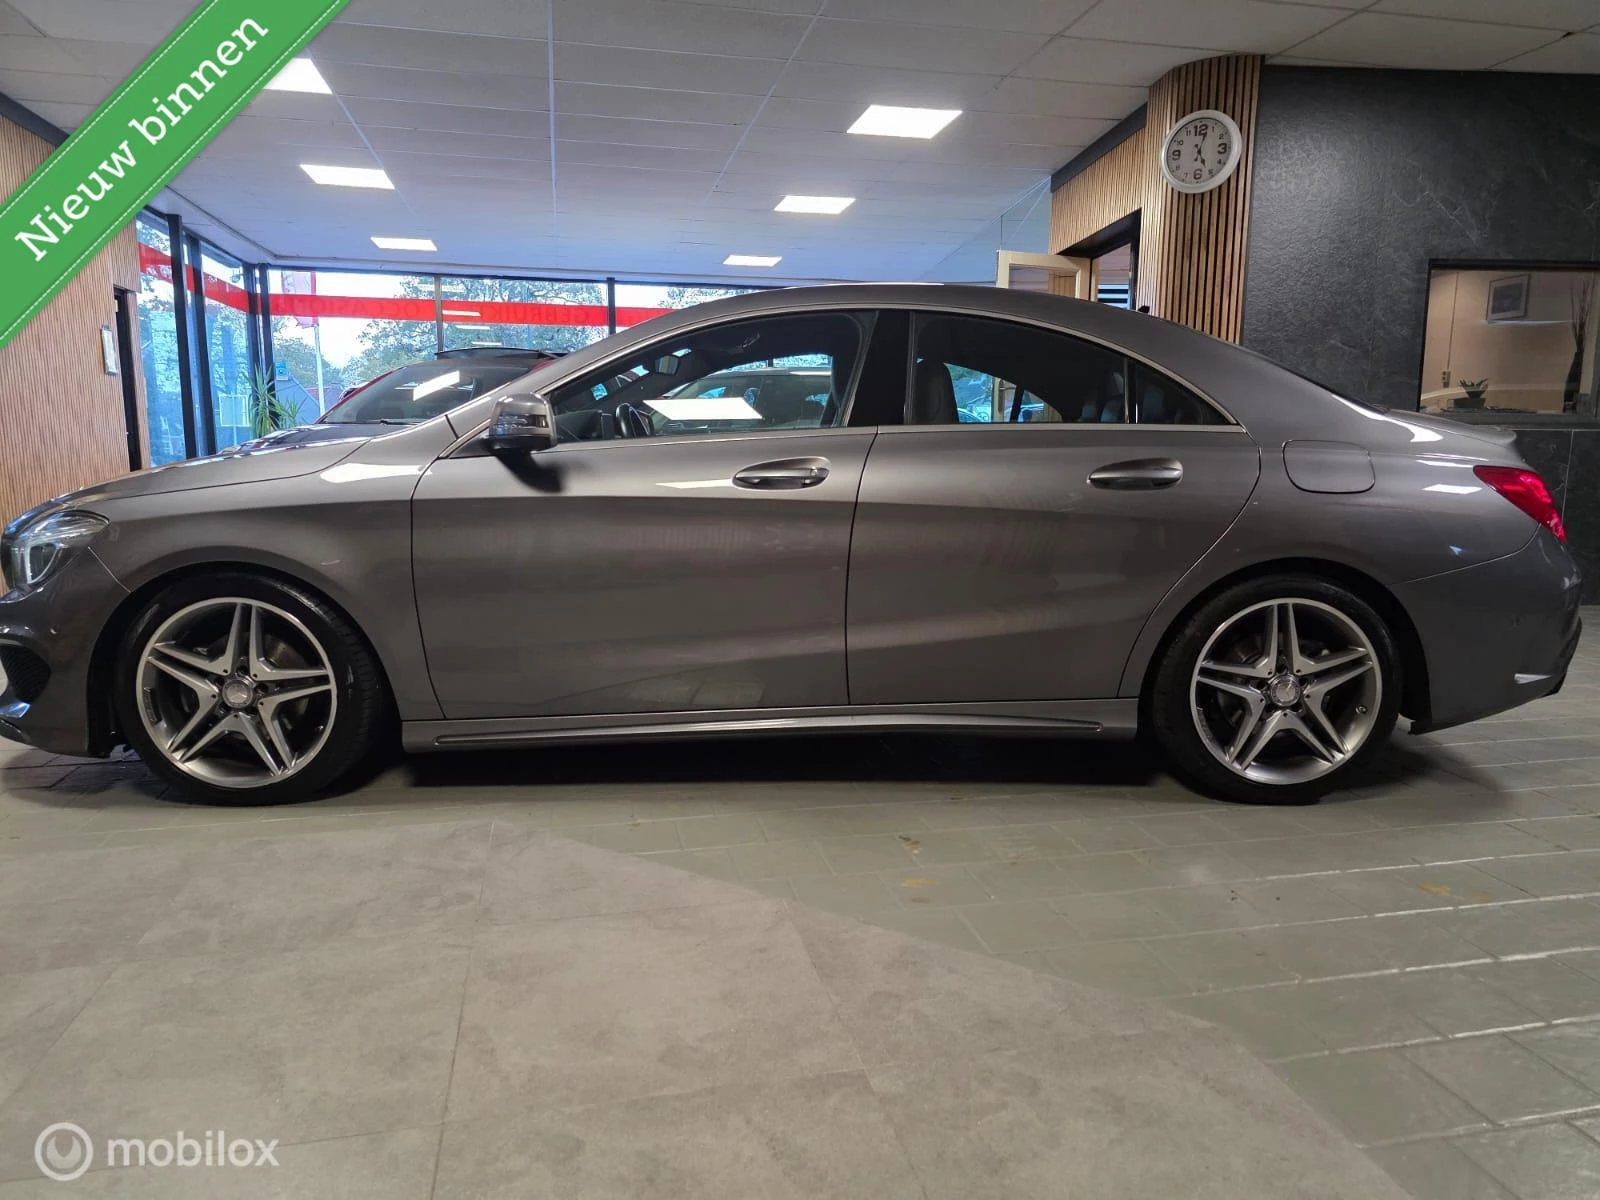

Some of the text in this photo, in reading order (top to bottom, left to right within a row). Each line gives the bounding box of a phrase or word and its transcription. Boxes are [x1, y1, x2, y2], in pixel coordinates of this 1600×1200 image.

[1193, 124, 1208, 136] 12
[1217, 142, 1228, 154] 3
[1172, 149, 1181, 160] 9
[1193, 168, 1202, 180] 6
